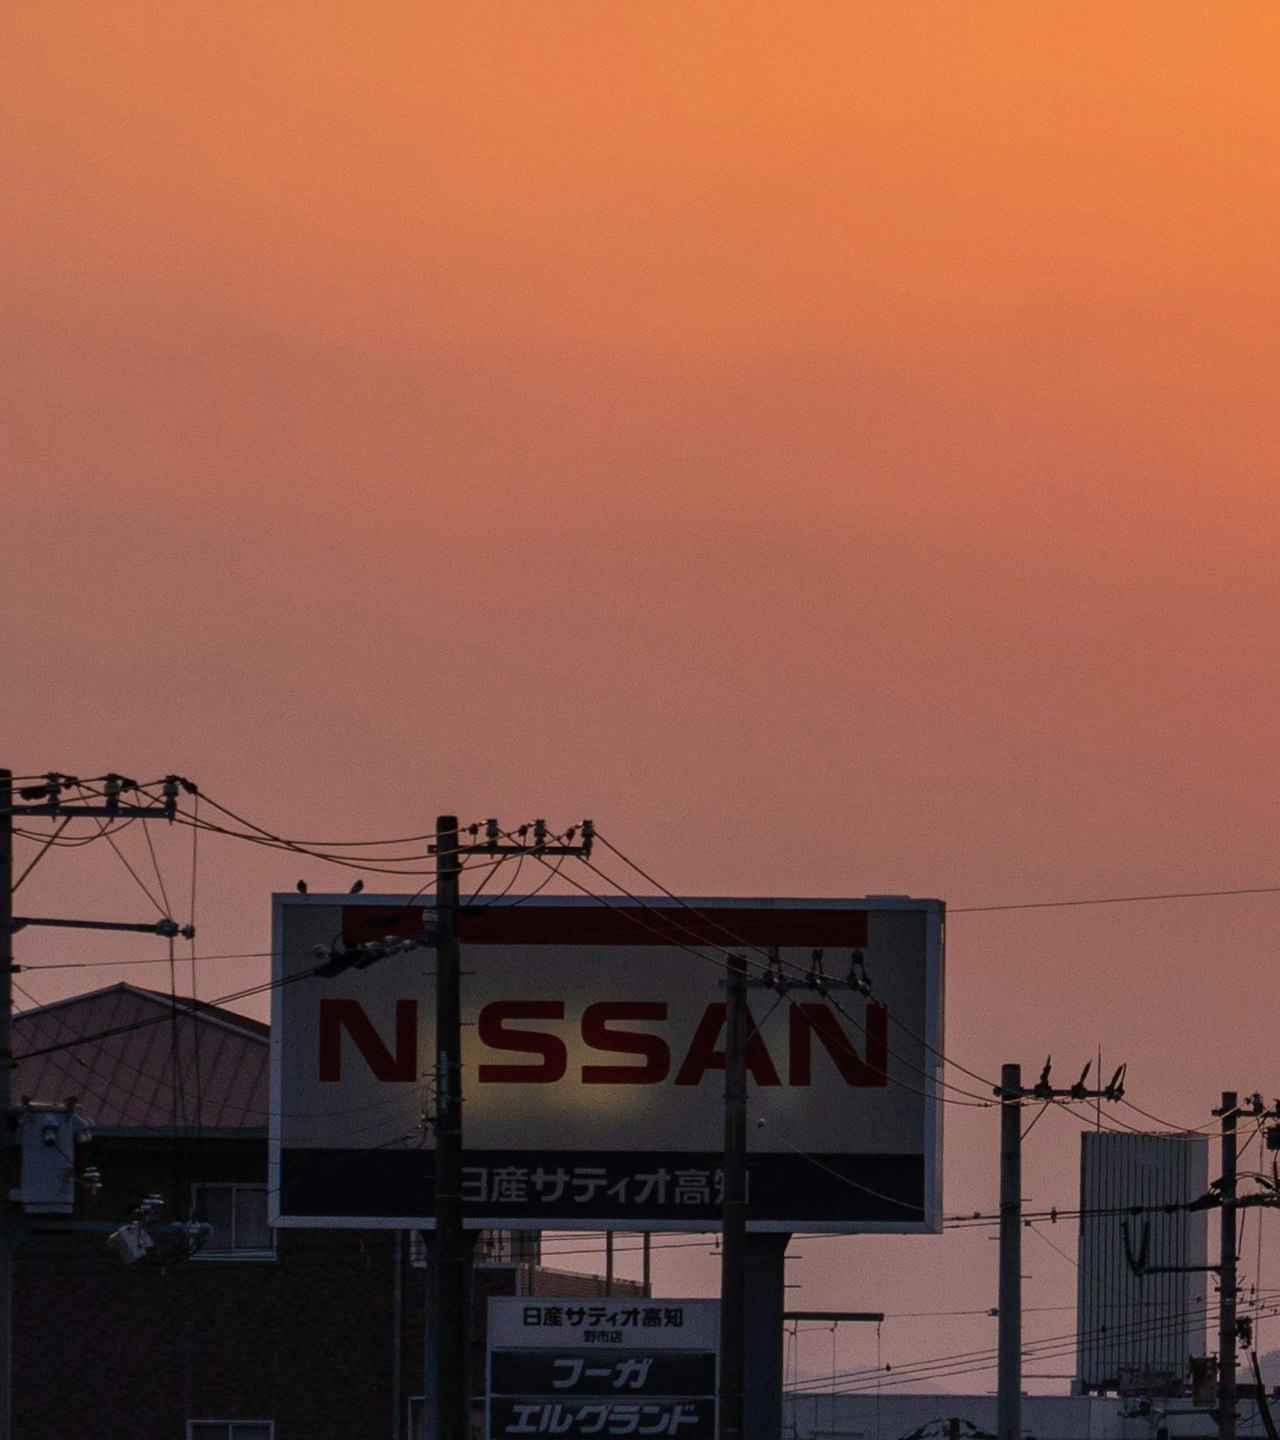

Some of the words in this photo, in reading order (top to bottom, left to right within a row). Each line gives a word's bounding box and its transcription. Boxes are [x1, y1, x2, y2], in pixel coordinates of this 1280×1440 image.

[320, 999, 888, 1087] NSSAN
[524, 1307, 683, 1327] 日産サティオ高知
[583, 1330, 623, 1344] 野市店
[553, 1358, 653, 1388] フーガ
[506, 1404, 700, 1435] エルグランド
